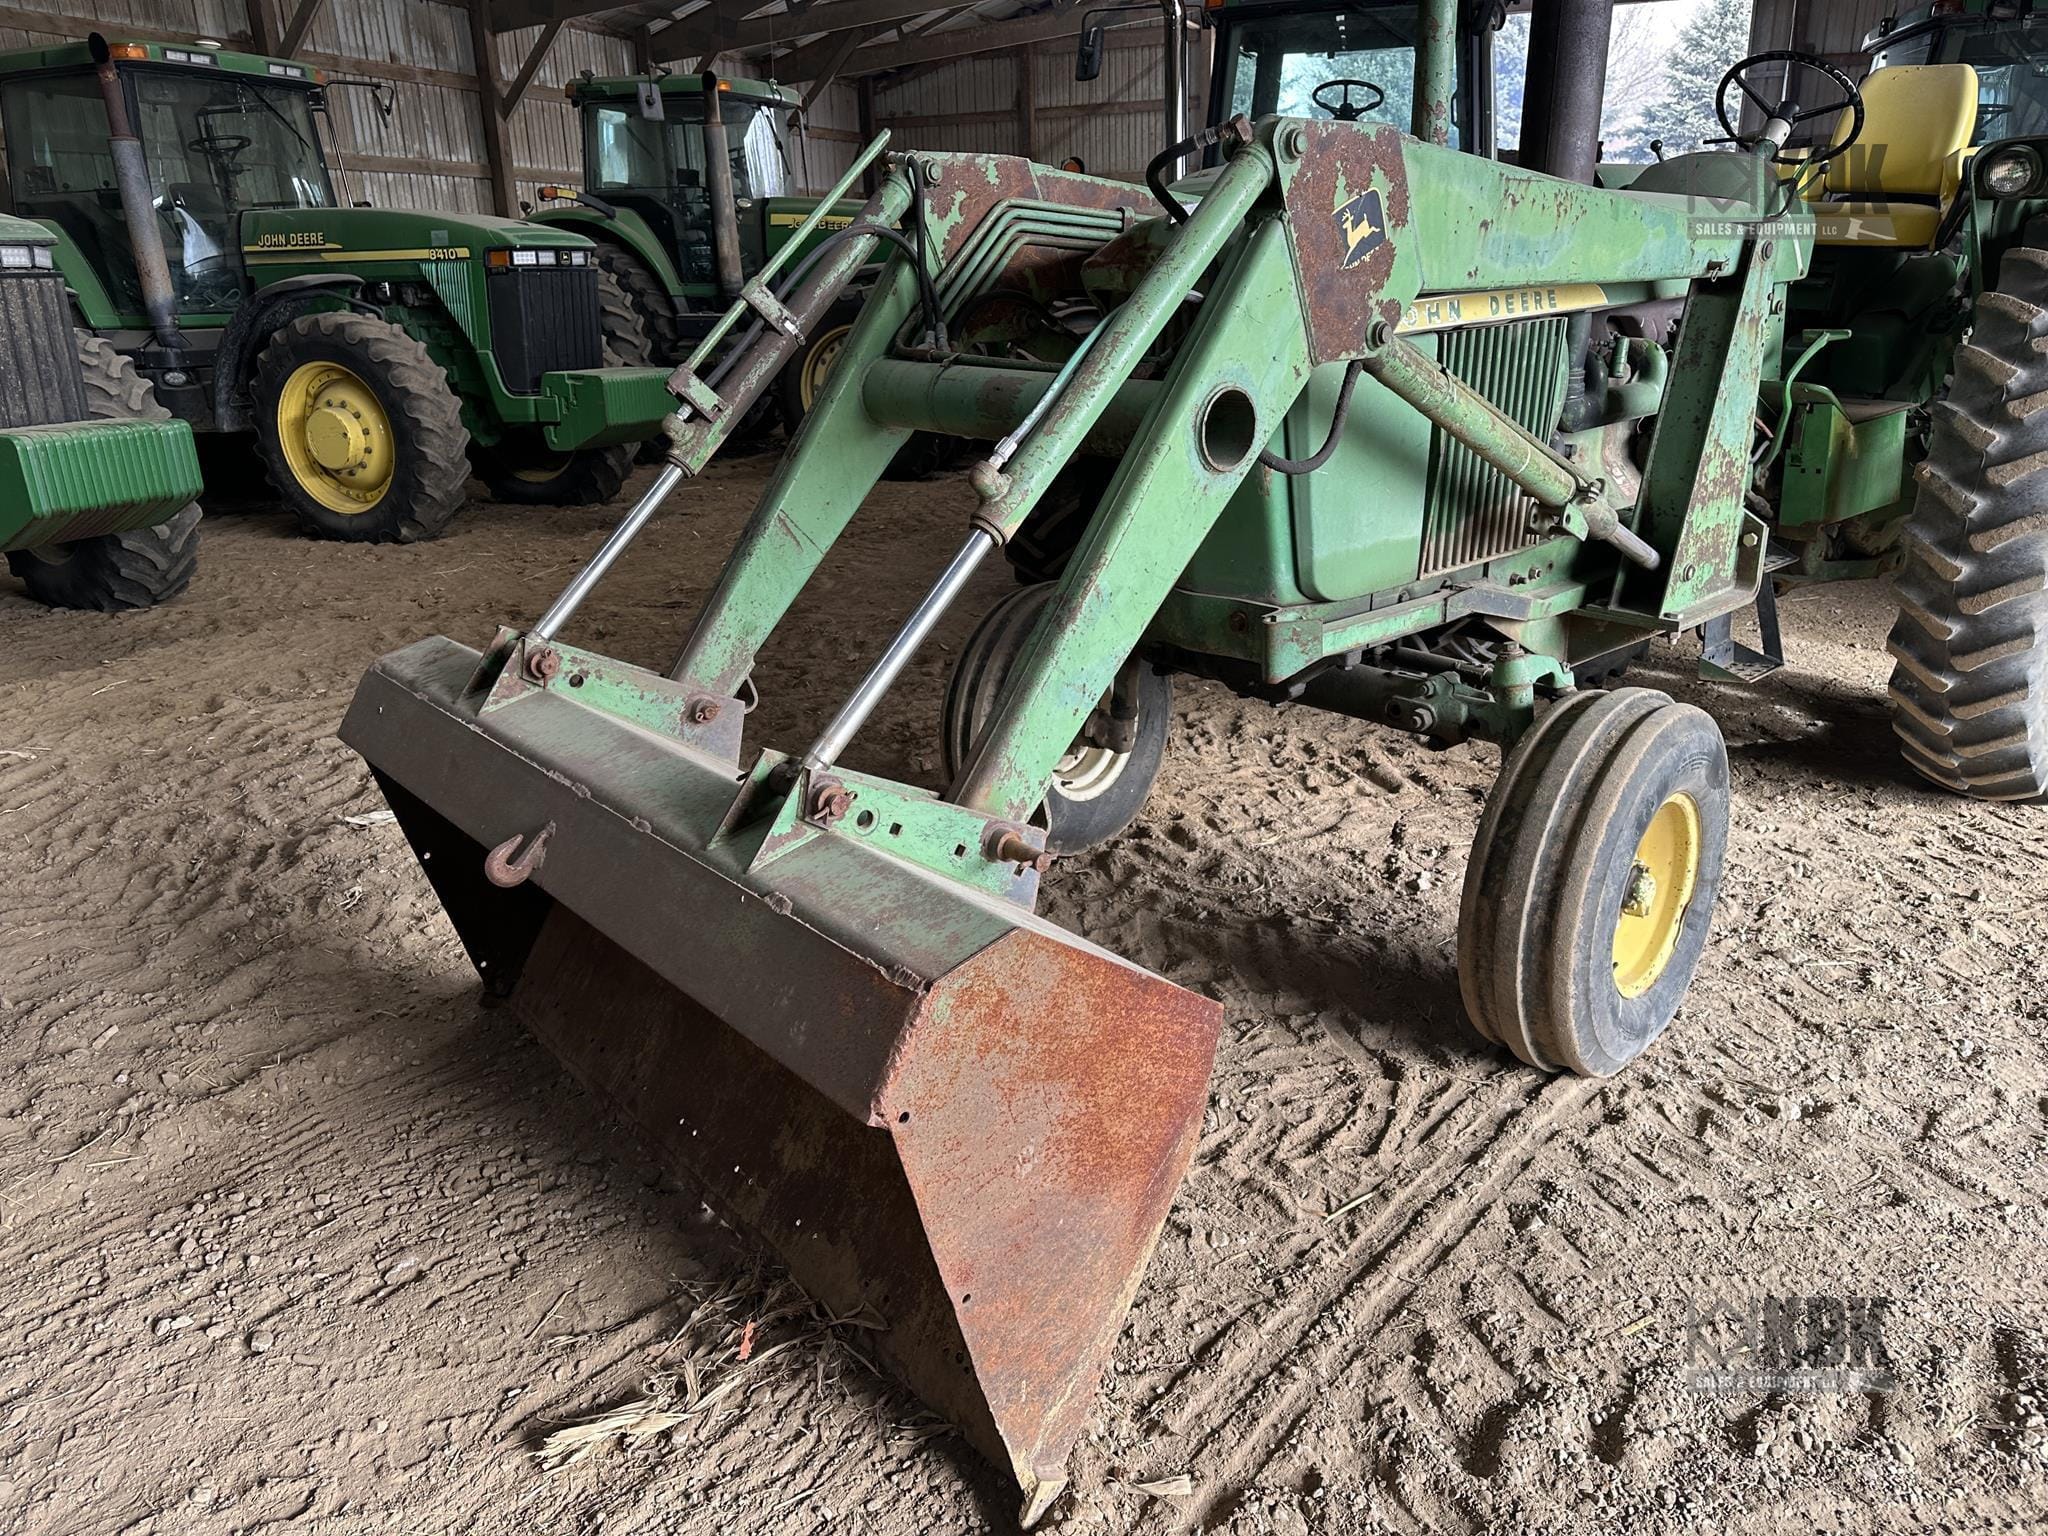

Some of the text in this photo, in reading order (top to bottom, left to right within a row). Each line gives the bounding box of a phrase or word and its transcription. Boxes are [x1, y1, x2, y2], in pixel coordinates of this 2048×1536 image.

[818, 219, 852, 230] DEER
[257, 231, 325, 248] JOHN DEERE
[429, 248, 457, 260] 8410
[1402, 288, 1558, 327] OHN DEERE
